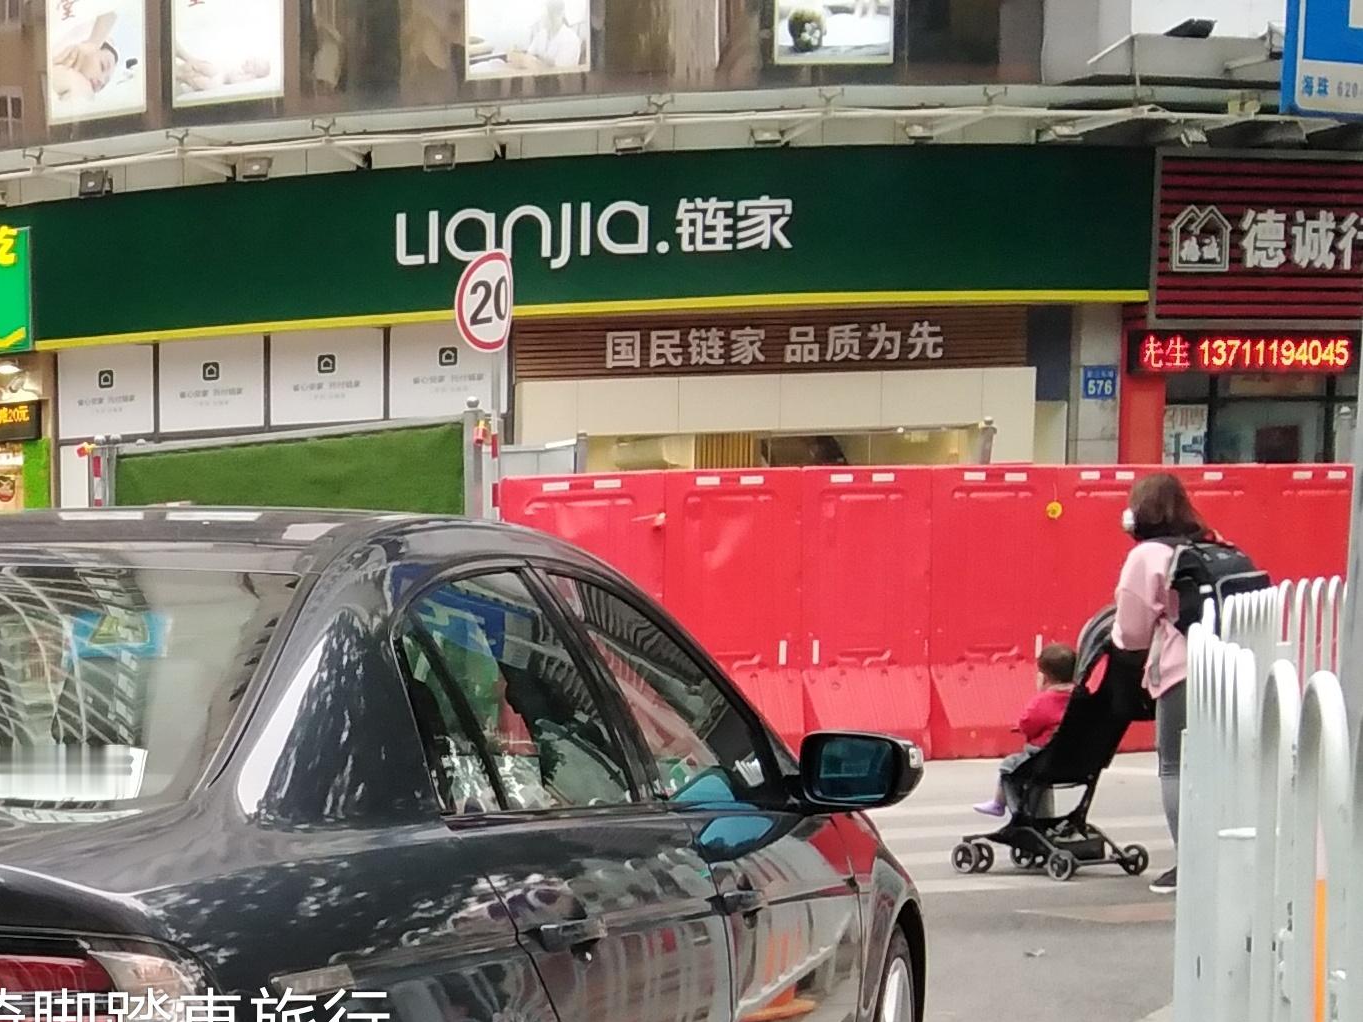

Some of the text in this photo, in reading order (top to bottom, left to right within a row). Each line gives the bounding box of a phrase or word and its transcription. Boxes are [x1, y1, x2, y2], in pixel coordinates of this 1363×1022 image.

[1301, 74, 1329, 97] 海珠
[468, 274, 508, 327] 20
[604, 320, 944, 369] 国民链家 品质为先
[1143, 334, 1350, 369] 先生 13711194045
[1087, 379, 1114, 396] 576
